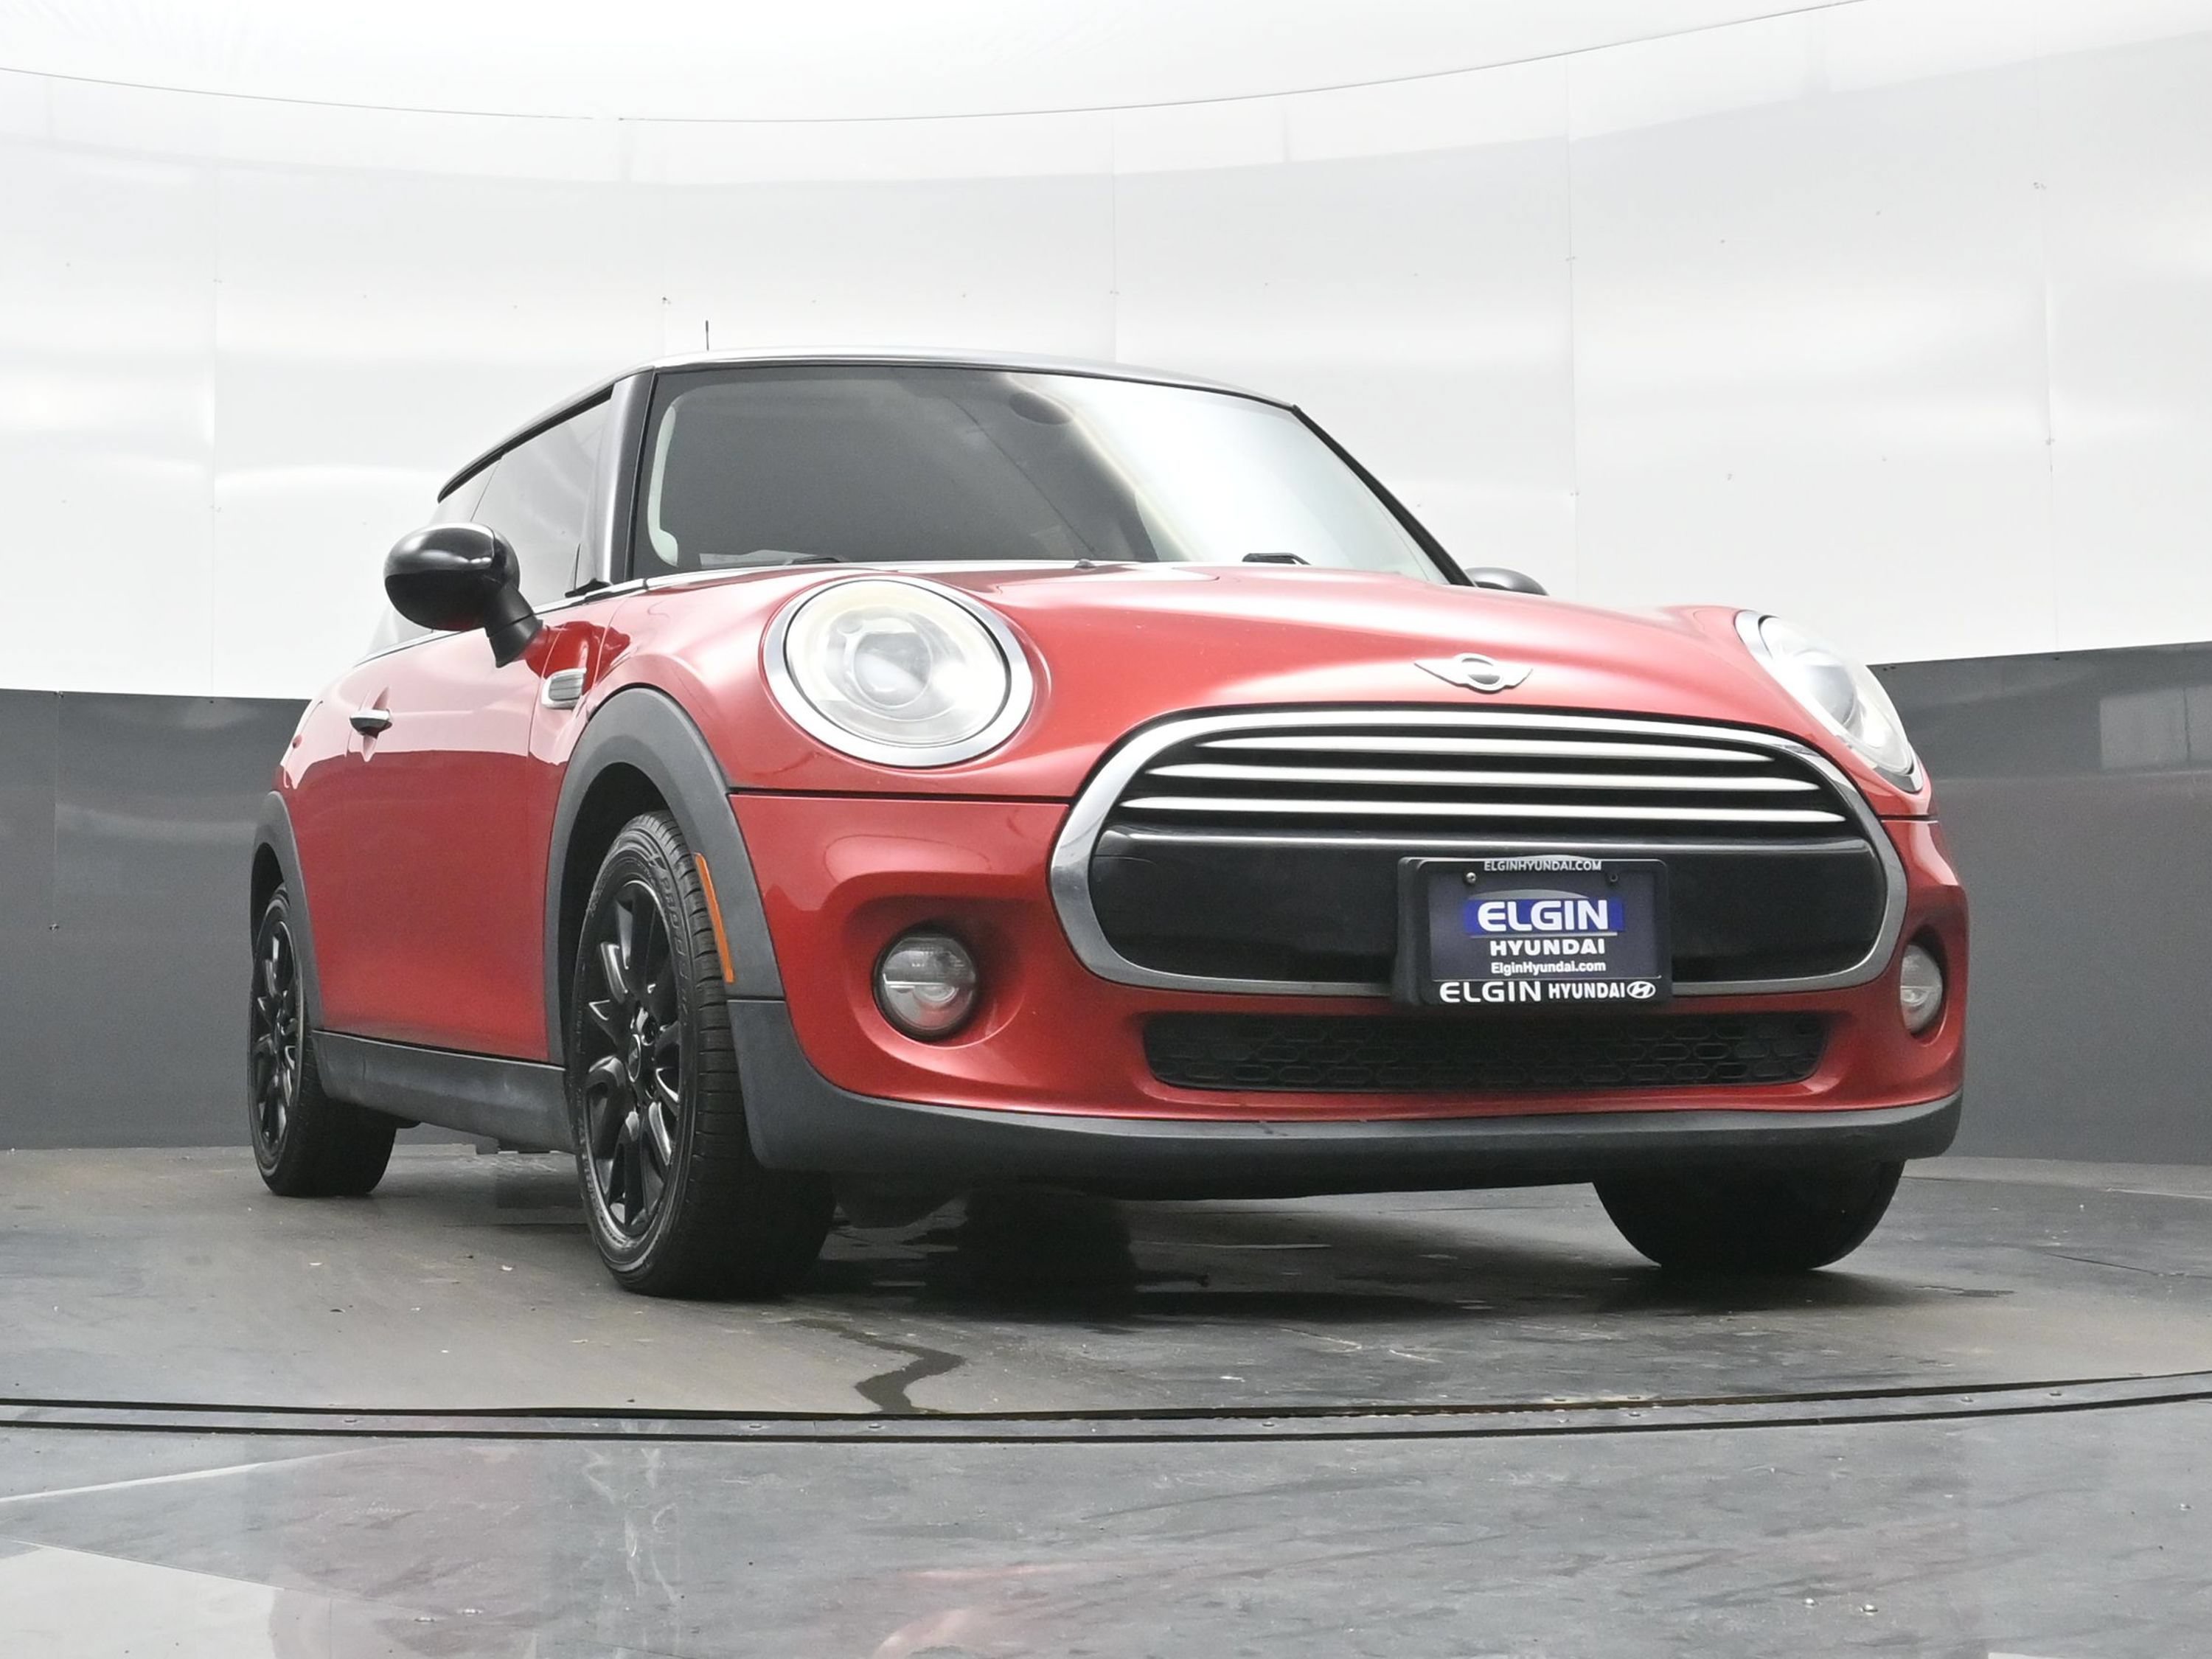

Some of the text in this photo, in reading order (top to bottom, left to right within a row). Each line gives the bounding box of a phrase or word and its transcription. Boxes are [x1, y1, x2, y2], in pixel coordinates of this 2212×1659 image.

[1484, 860, 1602, 872] ELGINHYUNDAI.COM
[1477, 900, 1609, 932] ELGIN
[1490, 938, 1605, 956] HYUNDAI
[1490, 960, 1607, 976] ElginHyundai.com
[1439, 980, 1625, 1003] ELGIN HYUNDAI
